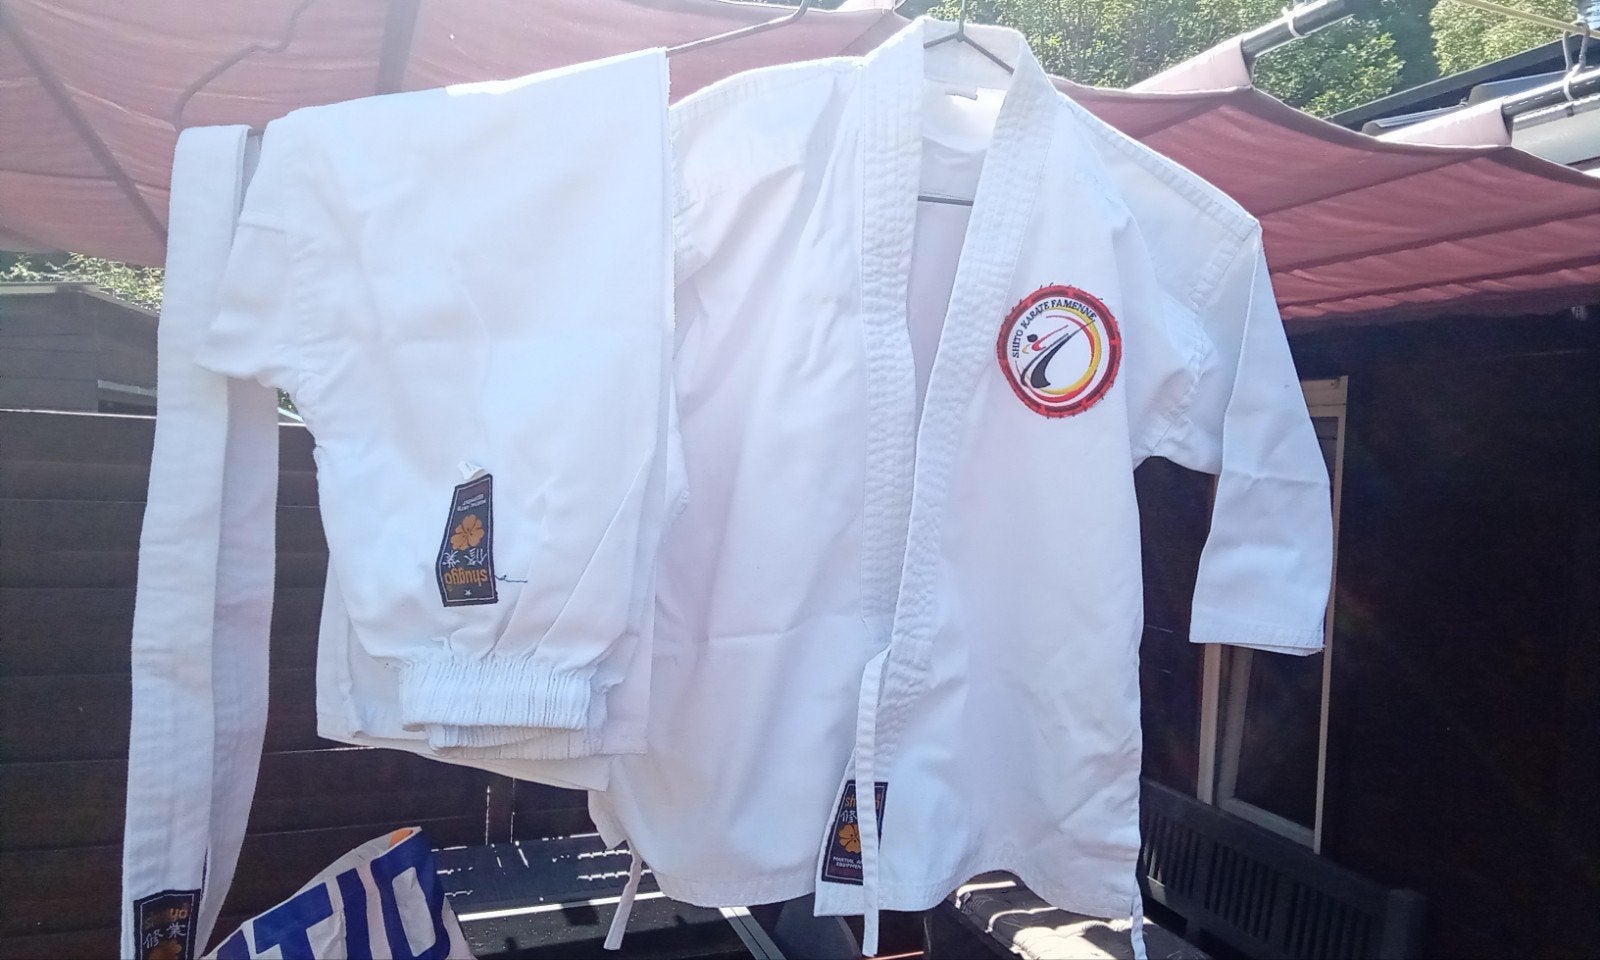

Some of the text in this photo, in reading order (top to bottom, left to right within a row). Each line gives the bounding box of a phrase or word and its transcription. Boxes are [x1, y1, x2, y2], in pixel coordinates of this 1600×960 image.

[1012, 299, 1097, 358] SHITO KARATE FAMENNE
[836, 861, 863, 870] EQUIPMEN
